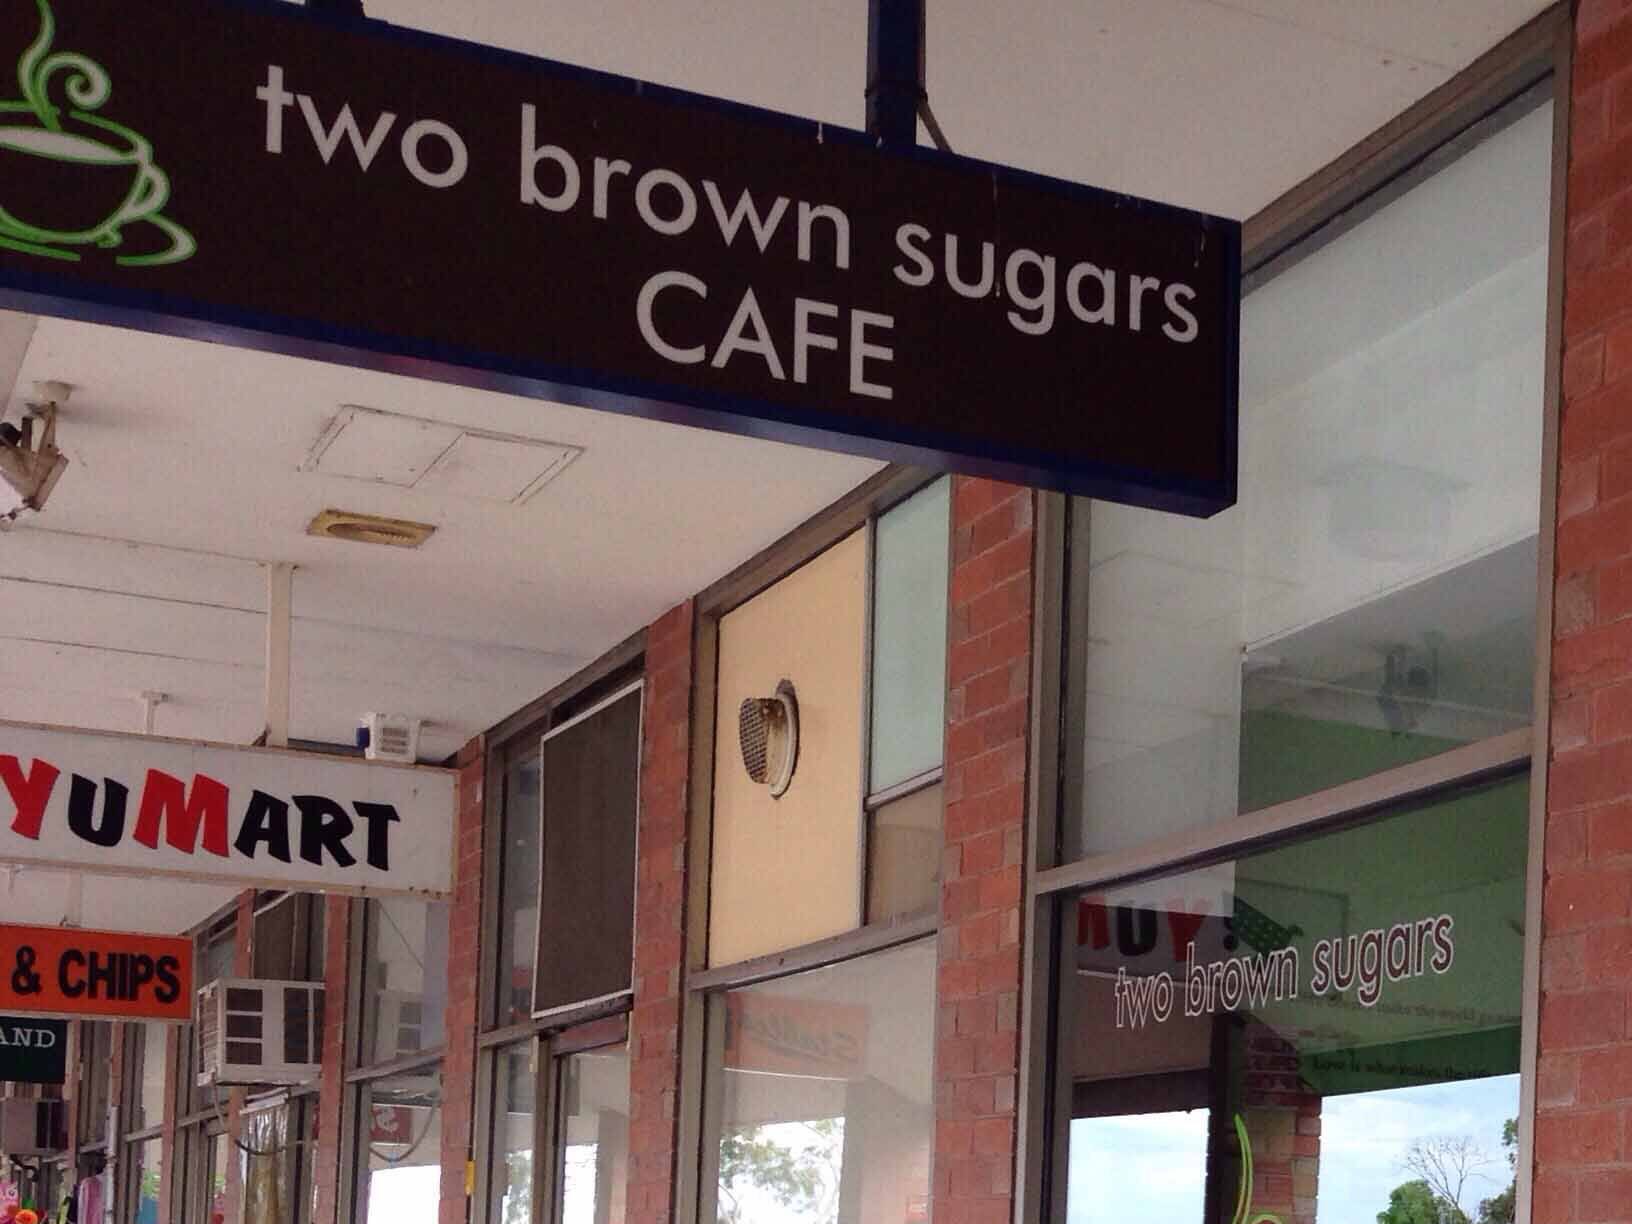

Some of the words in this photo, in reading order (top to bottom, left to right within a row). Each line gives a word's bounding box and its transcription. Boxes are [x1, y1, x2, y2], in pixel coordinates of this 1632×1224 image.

[255, 66, 470, 190] two
[519, 103, 852, 270] brown
[893, 219, 1202, 344] sugars
[634, 269, 897, 402] CAFE
[0, 754, 401, 872] YUMART
[10, 945, 42, 996] &
[57, 948, 181, 1004] CHIPS
[1114, 966, 1174, 1031] two
[1184, 941, 1299, 1017] brown
[1311, 913, 1454, 1006] sugars
